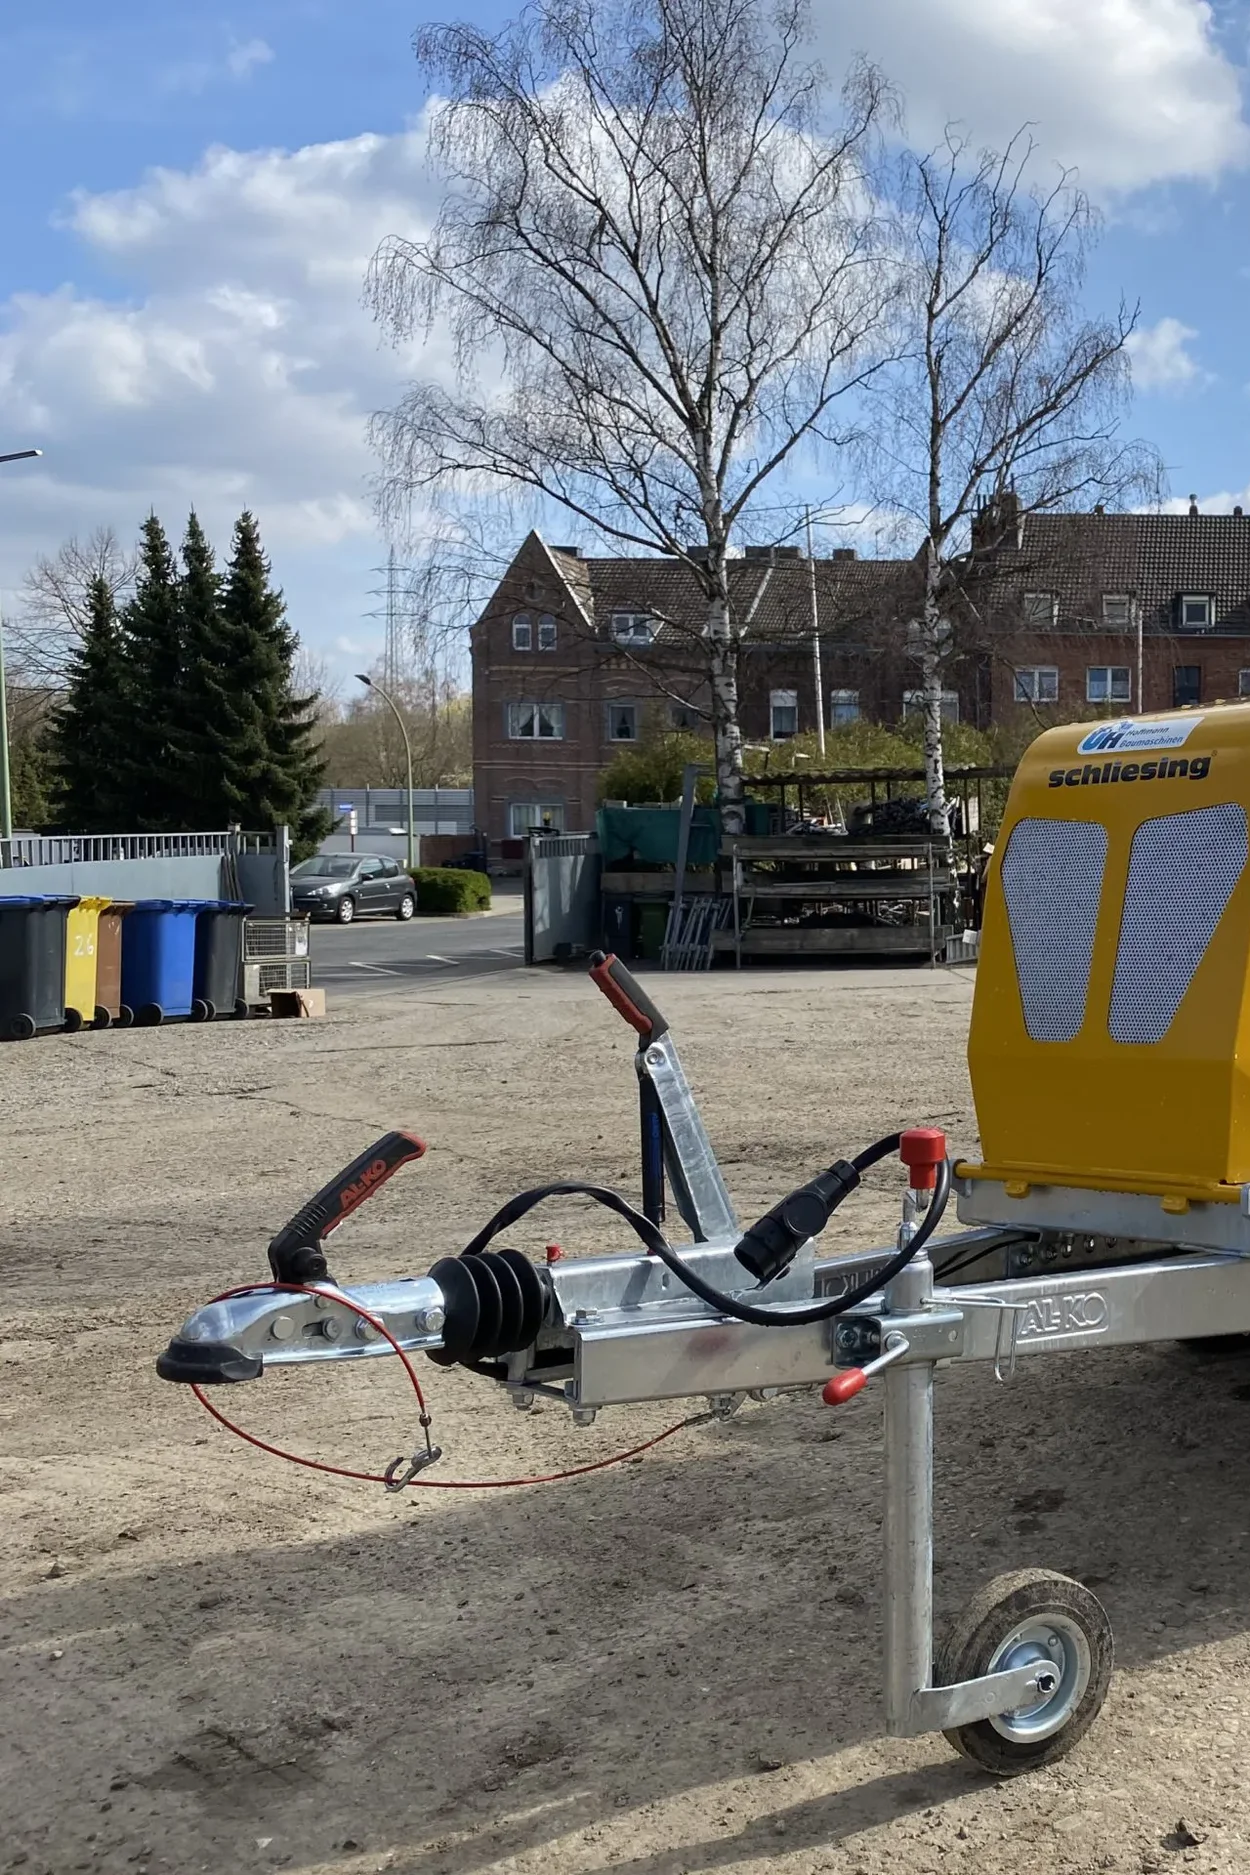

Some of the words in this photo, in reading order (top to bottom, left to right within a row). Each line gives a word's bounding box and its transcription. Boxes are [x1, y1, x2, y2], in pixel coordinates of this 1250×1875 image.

[1119, 736, 1183, 748] Baumaschinen
[1126, 727, 1169, 737] Hoffmann
[1048, 757, 1211, 788] schliesing
[74, 933, 94, 955] 26
[340, 1159, 387, 1209] AL-KO
[1019, 1291, 1108, 1336] AL-KO
